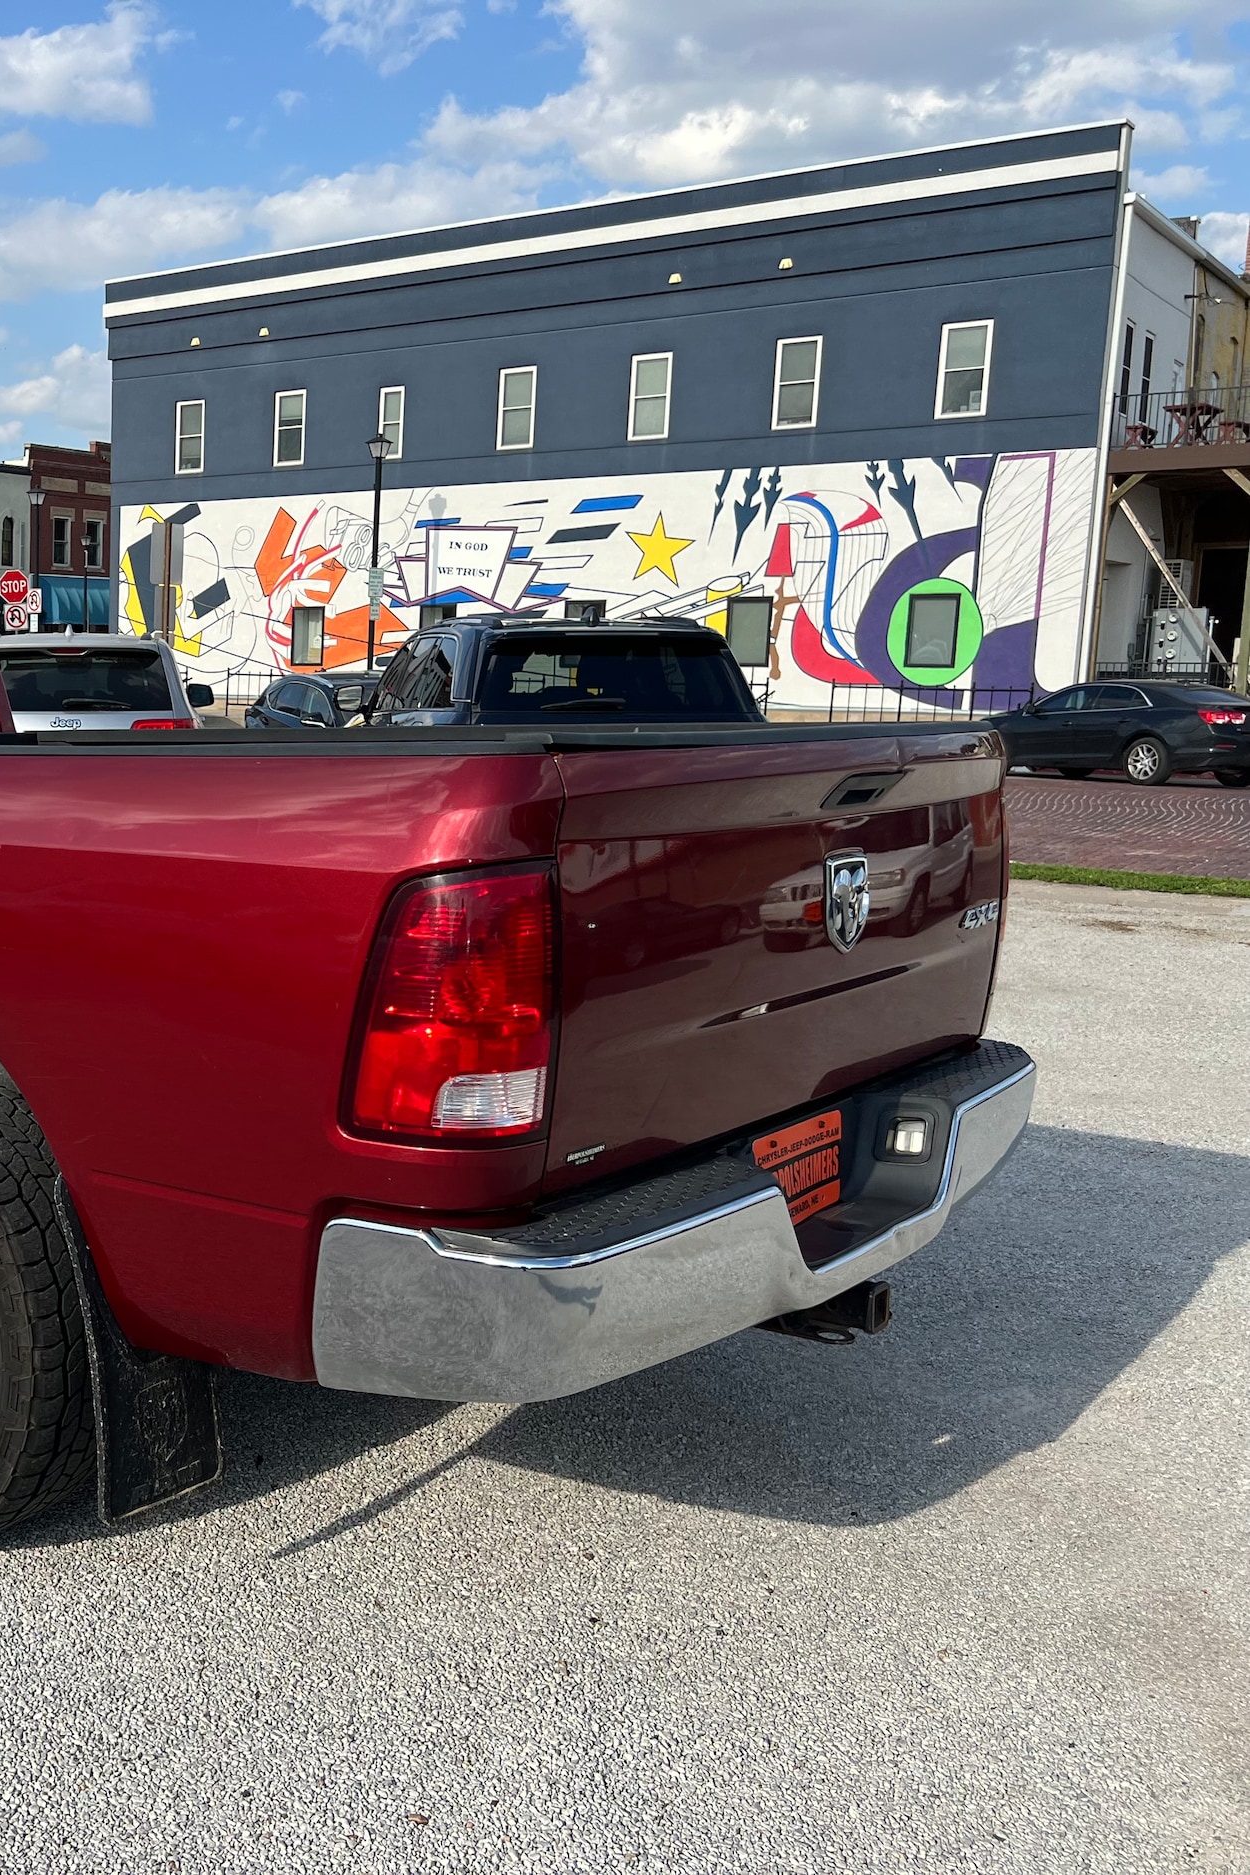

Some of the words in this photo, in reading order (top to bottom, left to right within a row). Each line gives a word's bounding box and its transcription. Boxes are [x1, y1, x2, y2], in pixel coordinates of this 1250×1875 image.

[449, 541, 462, 550] IN
[465, 542, 488, 552] GOD
[437, 566, 453, 575] WE
[456, 567, 492, 578] TRUST
[1, 580, 27, 594] STOP
[50, 717, 82, 730] Jeep
[757, 1127, 840, 1166] CHRYSLER-JEEP-DODGE-RAM
[772, 1145, 840, 1198] POLSHEIMERS
